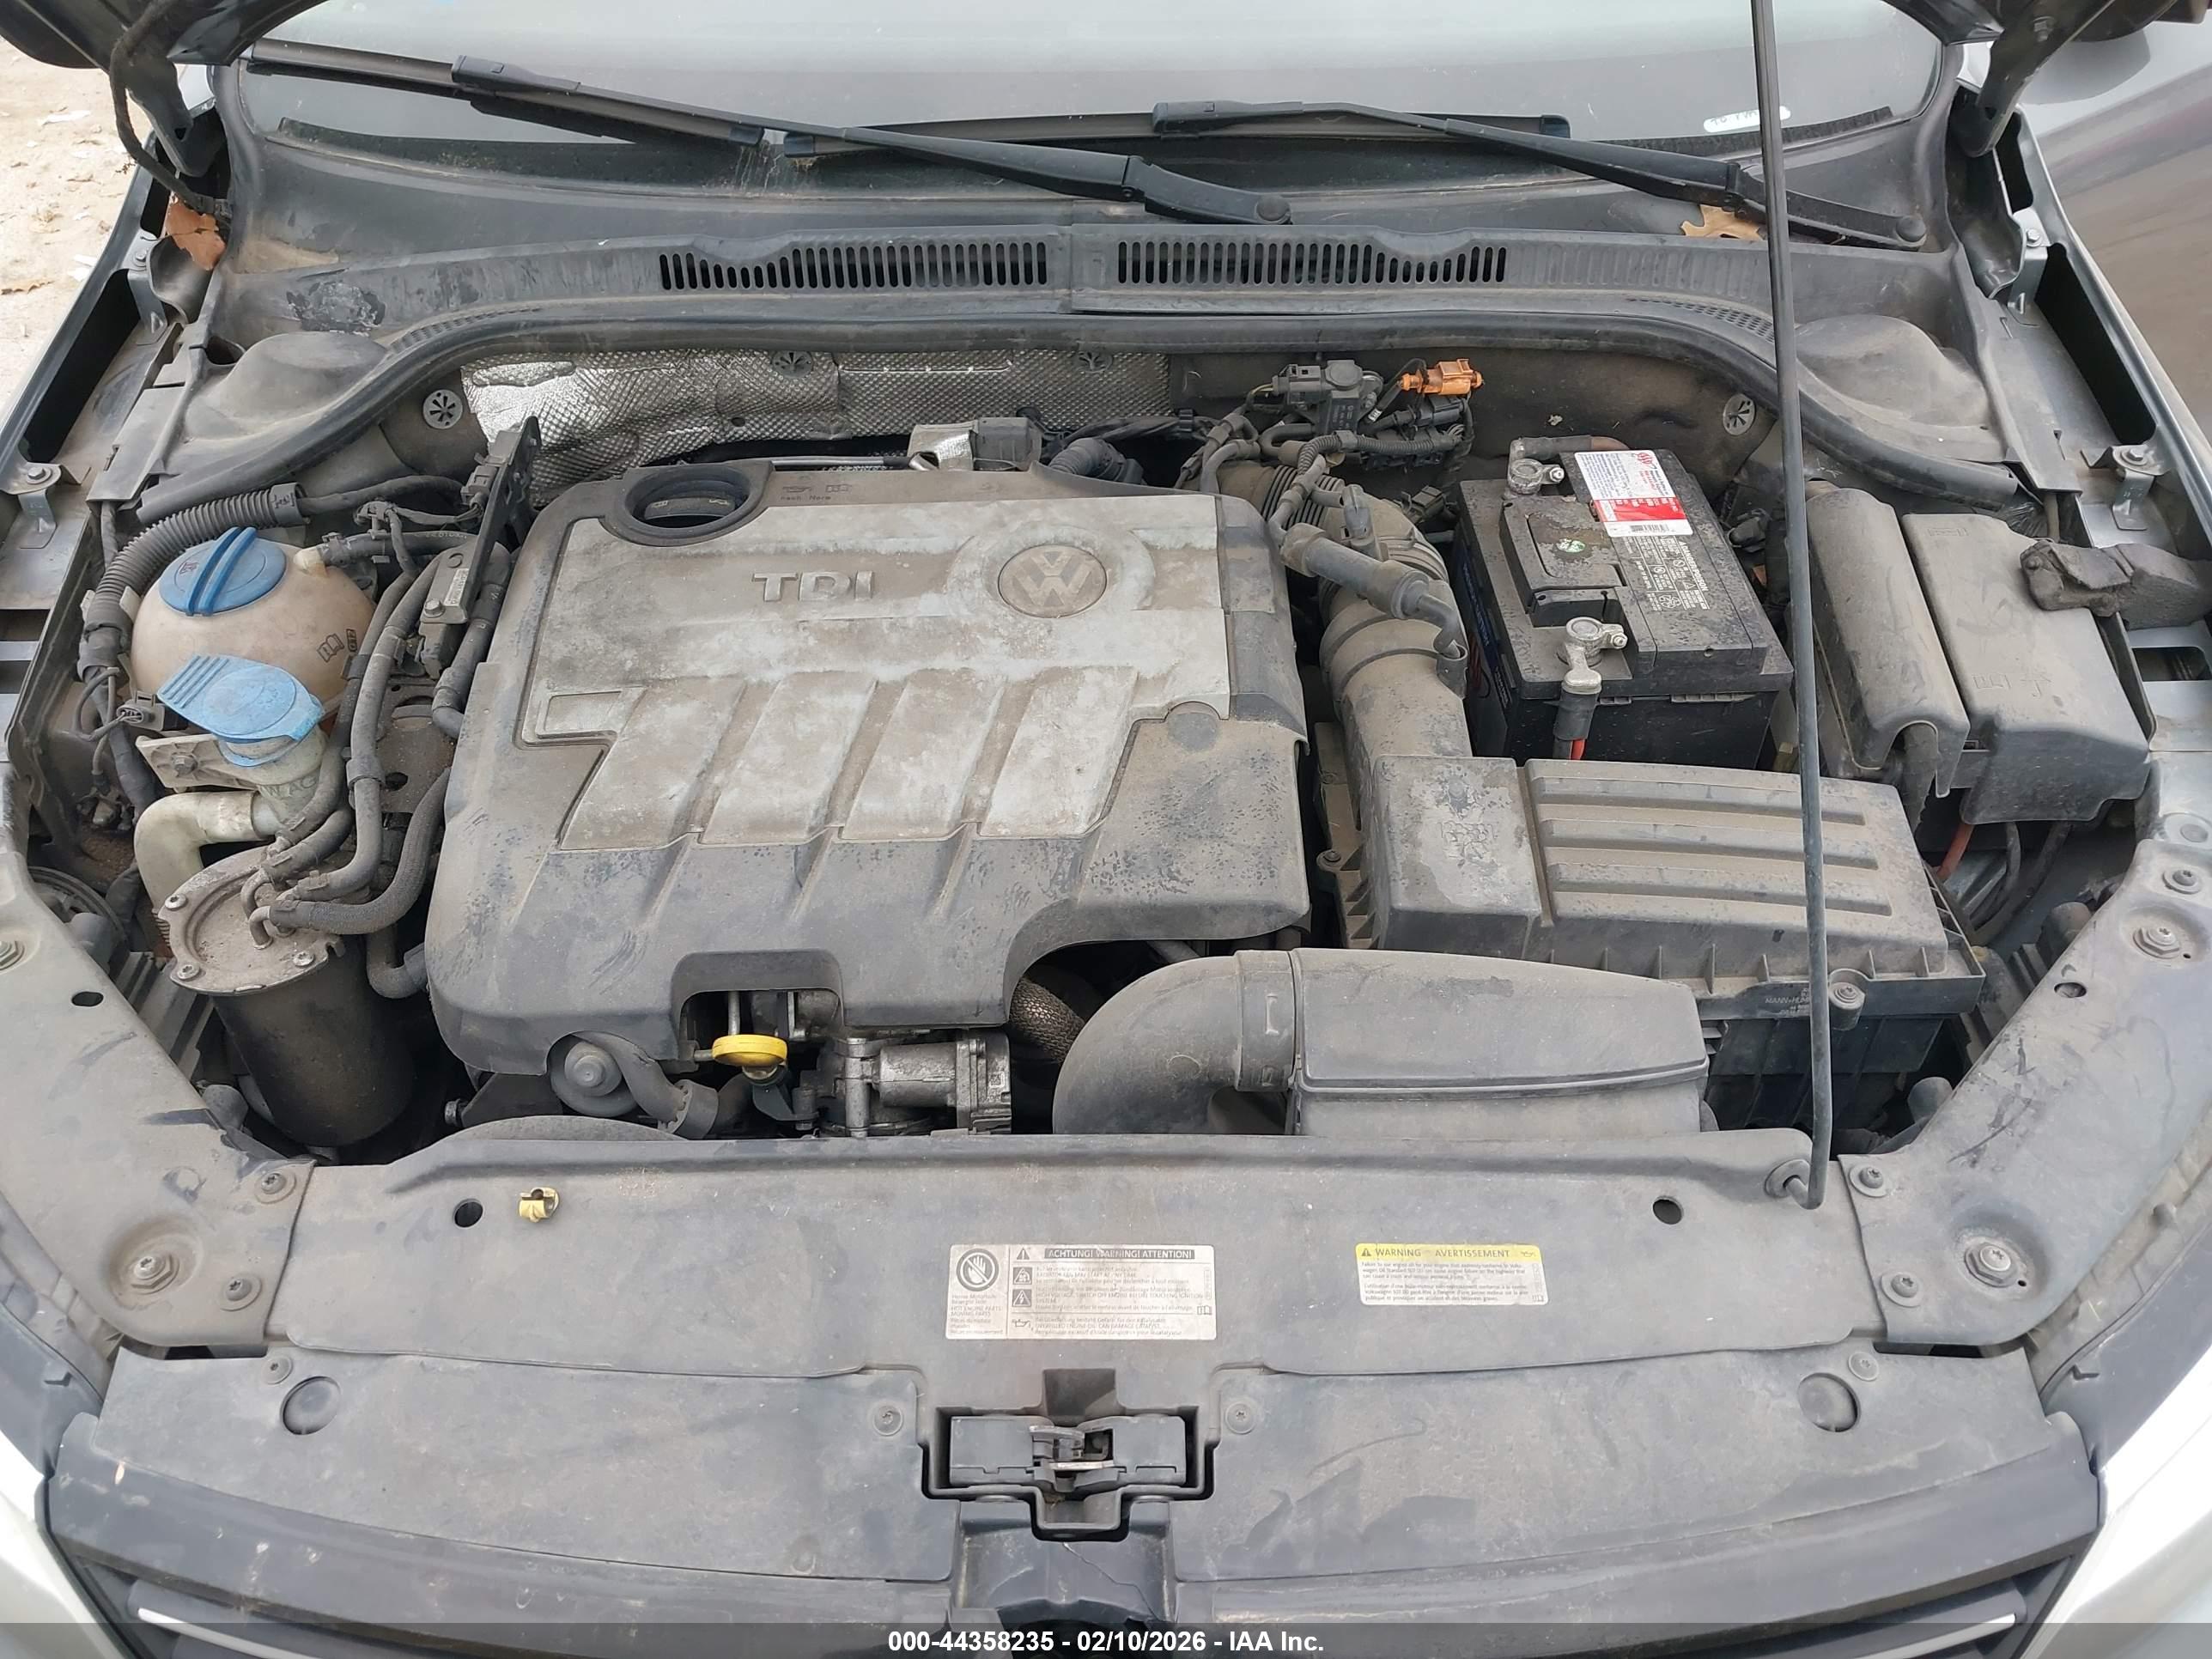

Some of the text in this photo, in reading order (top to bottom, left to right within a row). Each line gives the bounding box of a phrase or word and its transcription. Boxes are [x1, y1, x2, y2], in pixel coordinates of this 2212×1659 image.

[751, 570, 875, 602] TDI
[1048, 1249, 1093, 1258] ACHTUNG!
[1142, 1249, 1192, 1259] ATTENTION!
[1375, 1248, 1510, 1258] WARNING AVERTISSEMENT
